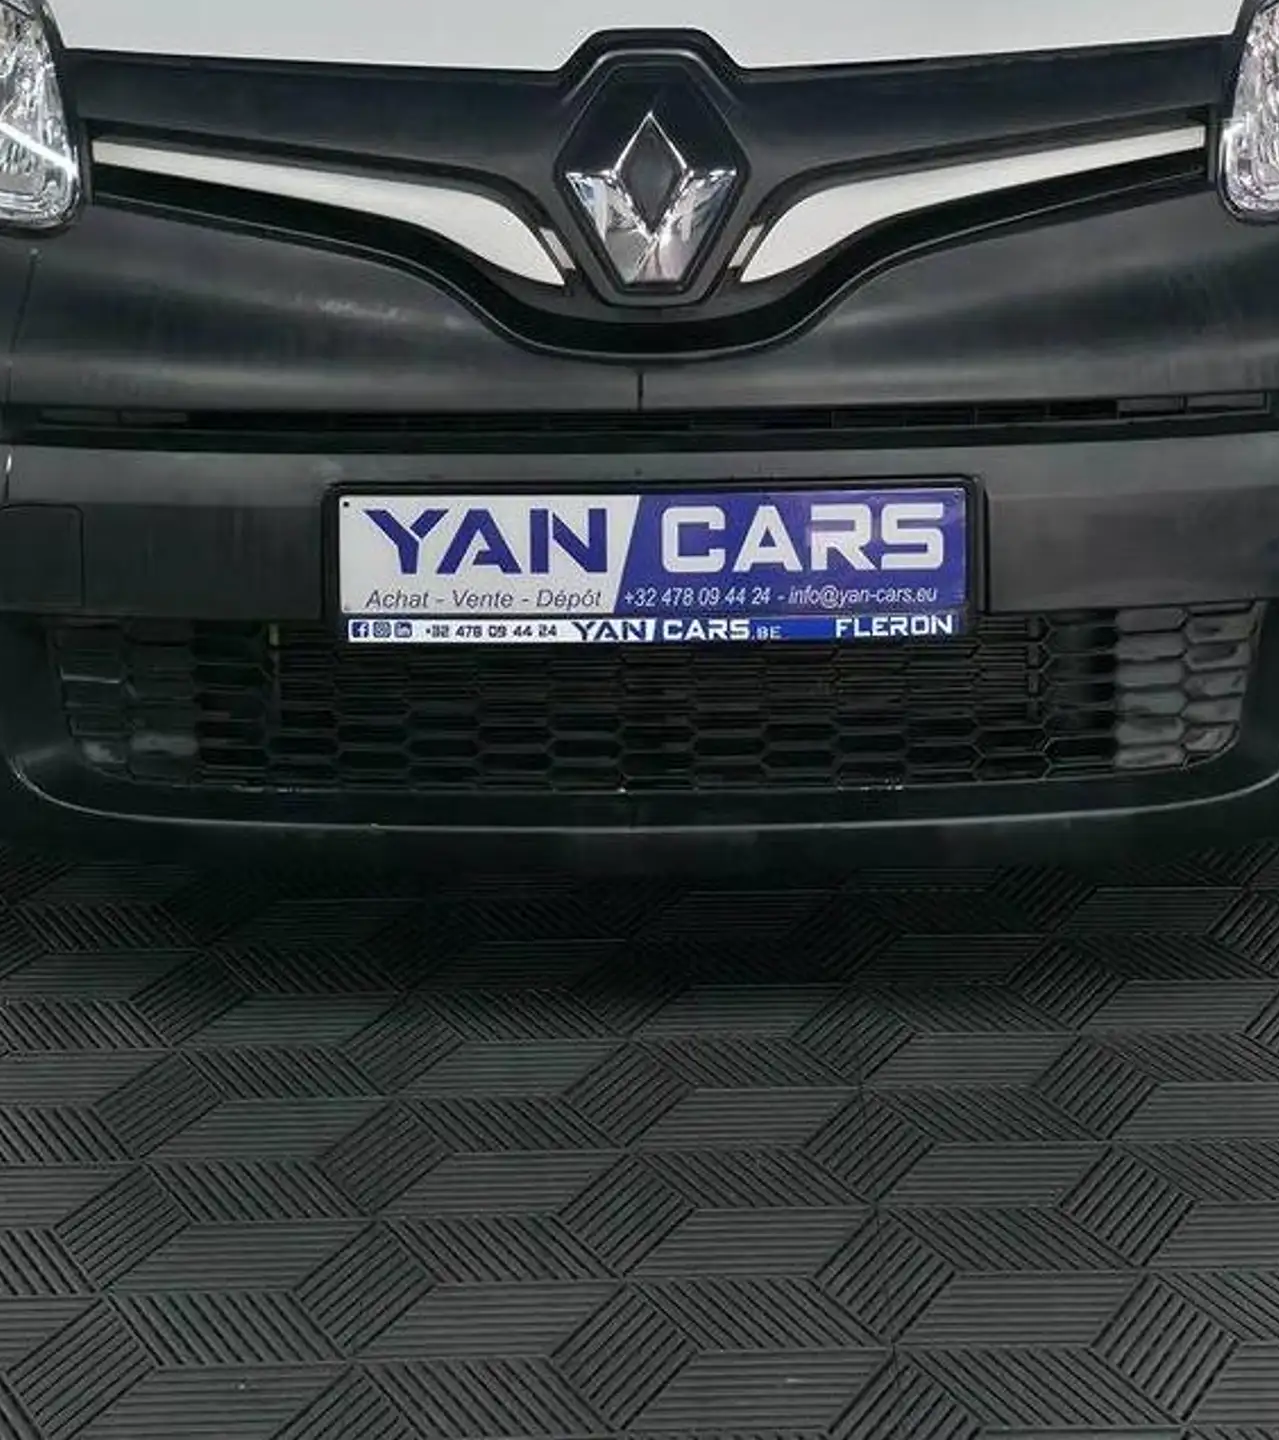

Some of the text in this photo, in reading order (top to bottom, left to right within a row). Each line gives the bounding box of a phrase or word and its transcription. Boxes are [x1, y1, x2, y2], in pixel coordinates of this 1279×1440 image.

[364, 502, 946, 575] YAN CARS
[364, 589, 429, 608] Achat
[452, 589, 513, 608] Vente
[624, 587, 658, 607] +32
[661, 587, 694, 607] 478
[697, 586, 720, 606] 09
[724, 586, 746, 605] 44
[751, 586, 772, 605] 24
[787, 584, 938, 609] info@yan-cars.eu
[513, 624, 533, 637] 44
[571, 620, 643, 641] YAN
[834, 614, 953, 639] FLERON
